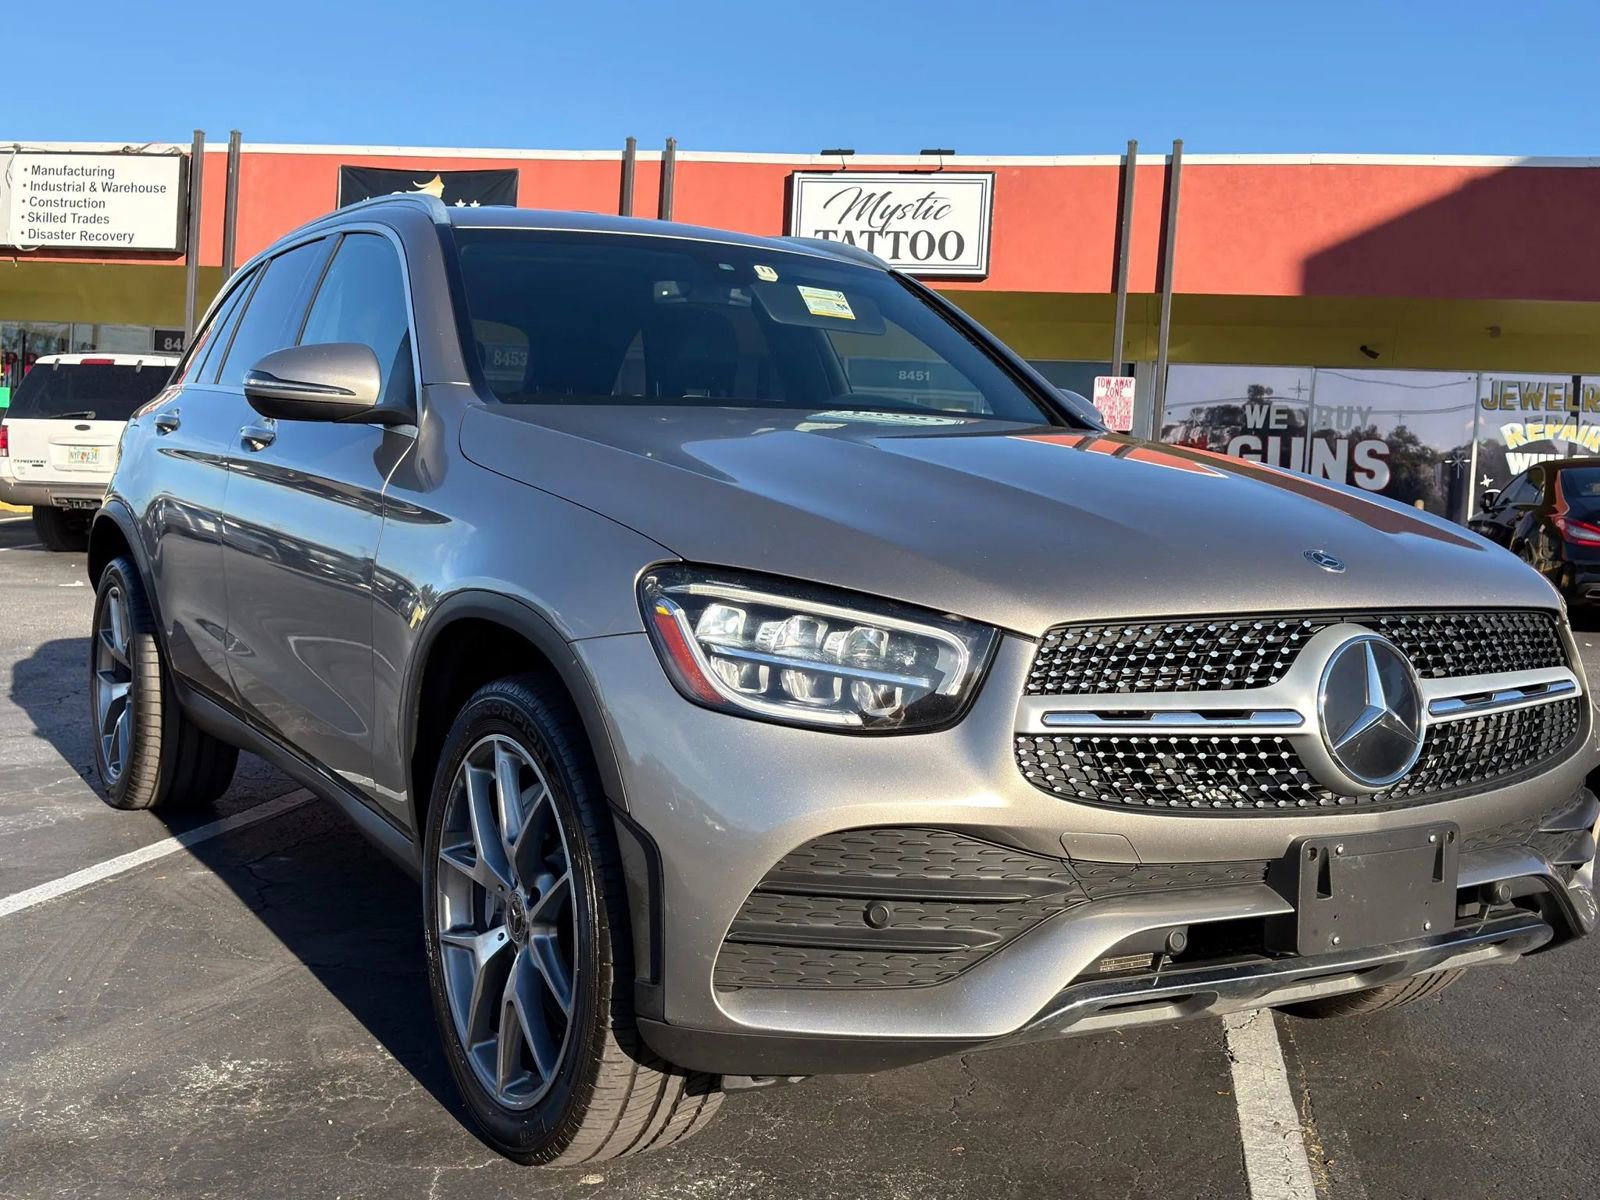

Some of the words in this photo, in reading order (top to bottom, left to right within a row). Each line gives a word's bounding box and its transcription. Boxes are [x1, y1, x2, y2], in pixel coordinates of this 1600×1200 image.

[31, 165, 115, 179] Manufacturing
[30, 181, 85, 192] Industrial
[89, 182, 97, 193] &
[101, 182, 167, 194] Warehouse
[29, 196, 106, 209] Construction
[823, 186, 953, 235] Mystic
[27, 212, 67, 223] Skilled
[71, 213, 110, 224] Trades
[28, 228, 76, 240] Disaster
[80, 230, 135, 243] Recovery
[898, 370, 930, 381] 8451
[1244, 404, 1288, 430] WE
[1314, 406, 1372, 431] BUY
